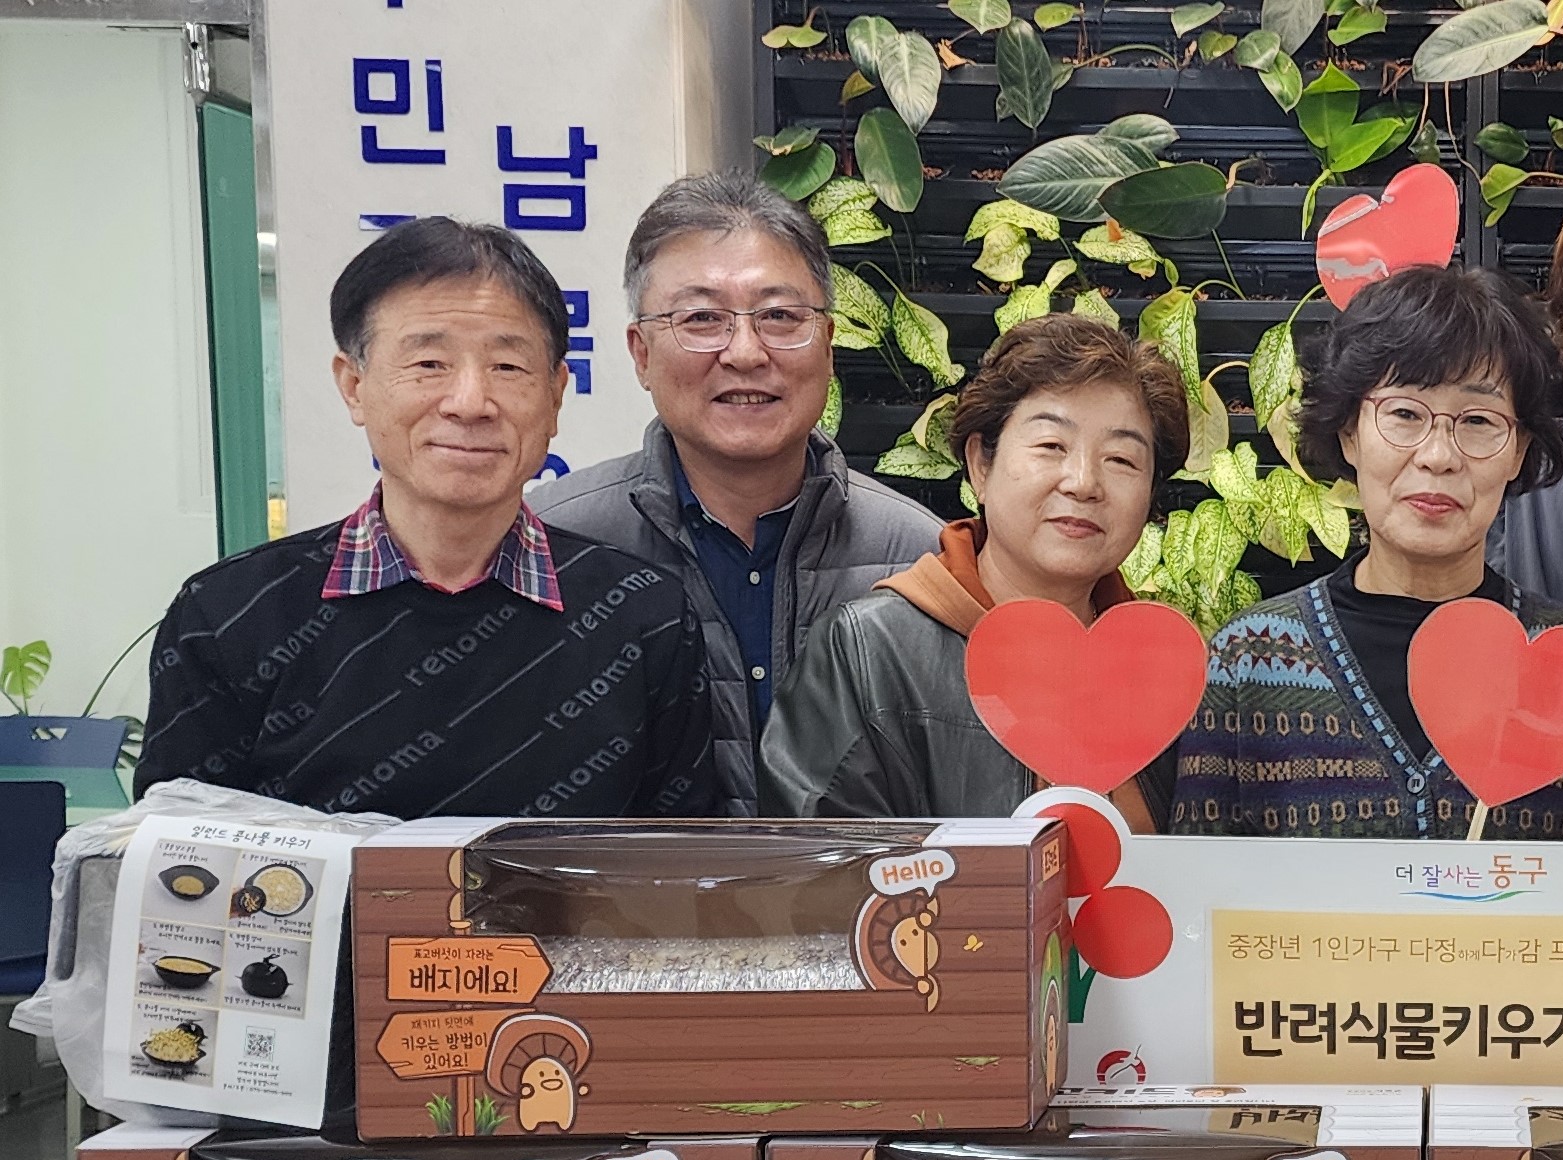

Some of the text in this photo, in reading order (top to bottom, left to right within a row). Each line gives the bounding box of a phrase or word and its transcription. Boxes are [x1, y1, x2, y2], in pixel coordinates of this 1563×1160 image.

[567, 567, 663, 640] renoma
[404, 604, 517, 686] renoma
[544, 642, 643, 730] renoma
[324, 730, 445, 812] renoma
[518, 735, 633, 817] renoma
[881, 857, 945, 885] Hello
[1395, 855, 1548, 889] 더 잘사는 동구
[414, 948, 494, 961] 표고버섯이 자라는
[1227, 934, 1301, 961] 중장년
[1312, 936, 1400, 963] 1인가구
[409, 964, 518, 994] 배지에요!
[402, 1032, 488, 1051] 키우는 방법이
[424, 1052, 468, 1070] 있어요!
